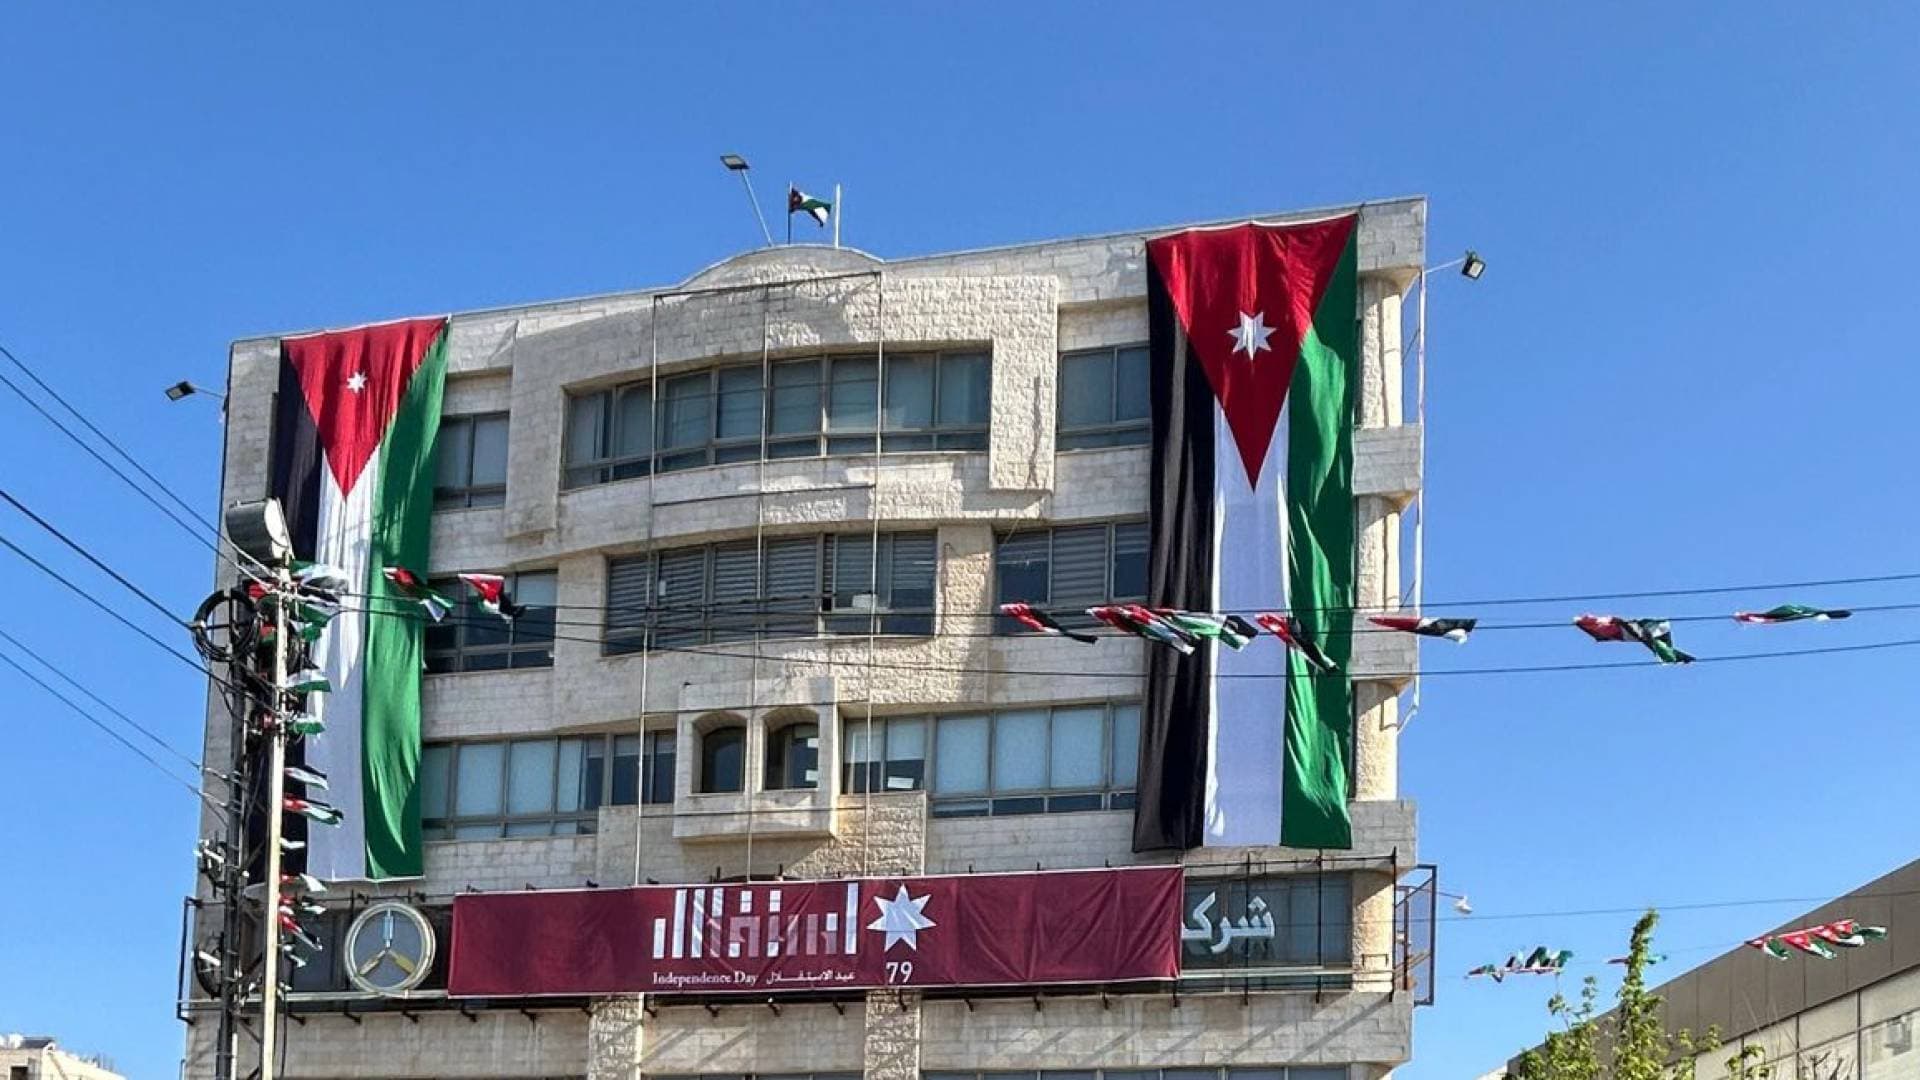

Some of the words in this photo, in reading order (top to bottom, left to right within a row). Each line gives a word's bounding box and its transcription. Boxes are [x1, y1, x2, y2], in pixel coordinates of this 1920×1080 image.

[1181, 891, 1275, 953] شرك
[652, 971, 731, 988] Independence
[734, 970, 759, 987] Day
[834, 970, 856, 982] عيد
[886, 961, 912, 984] 79
